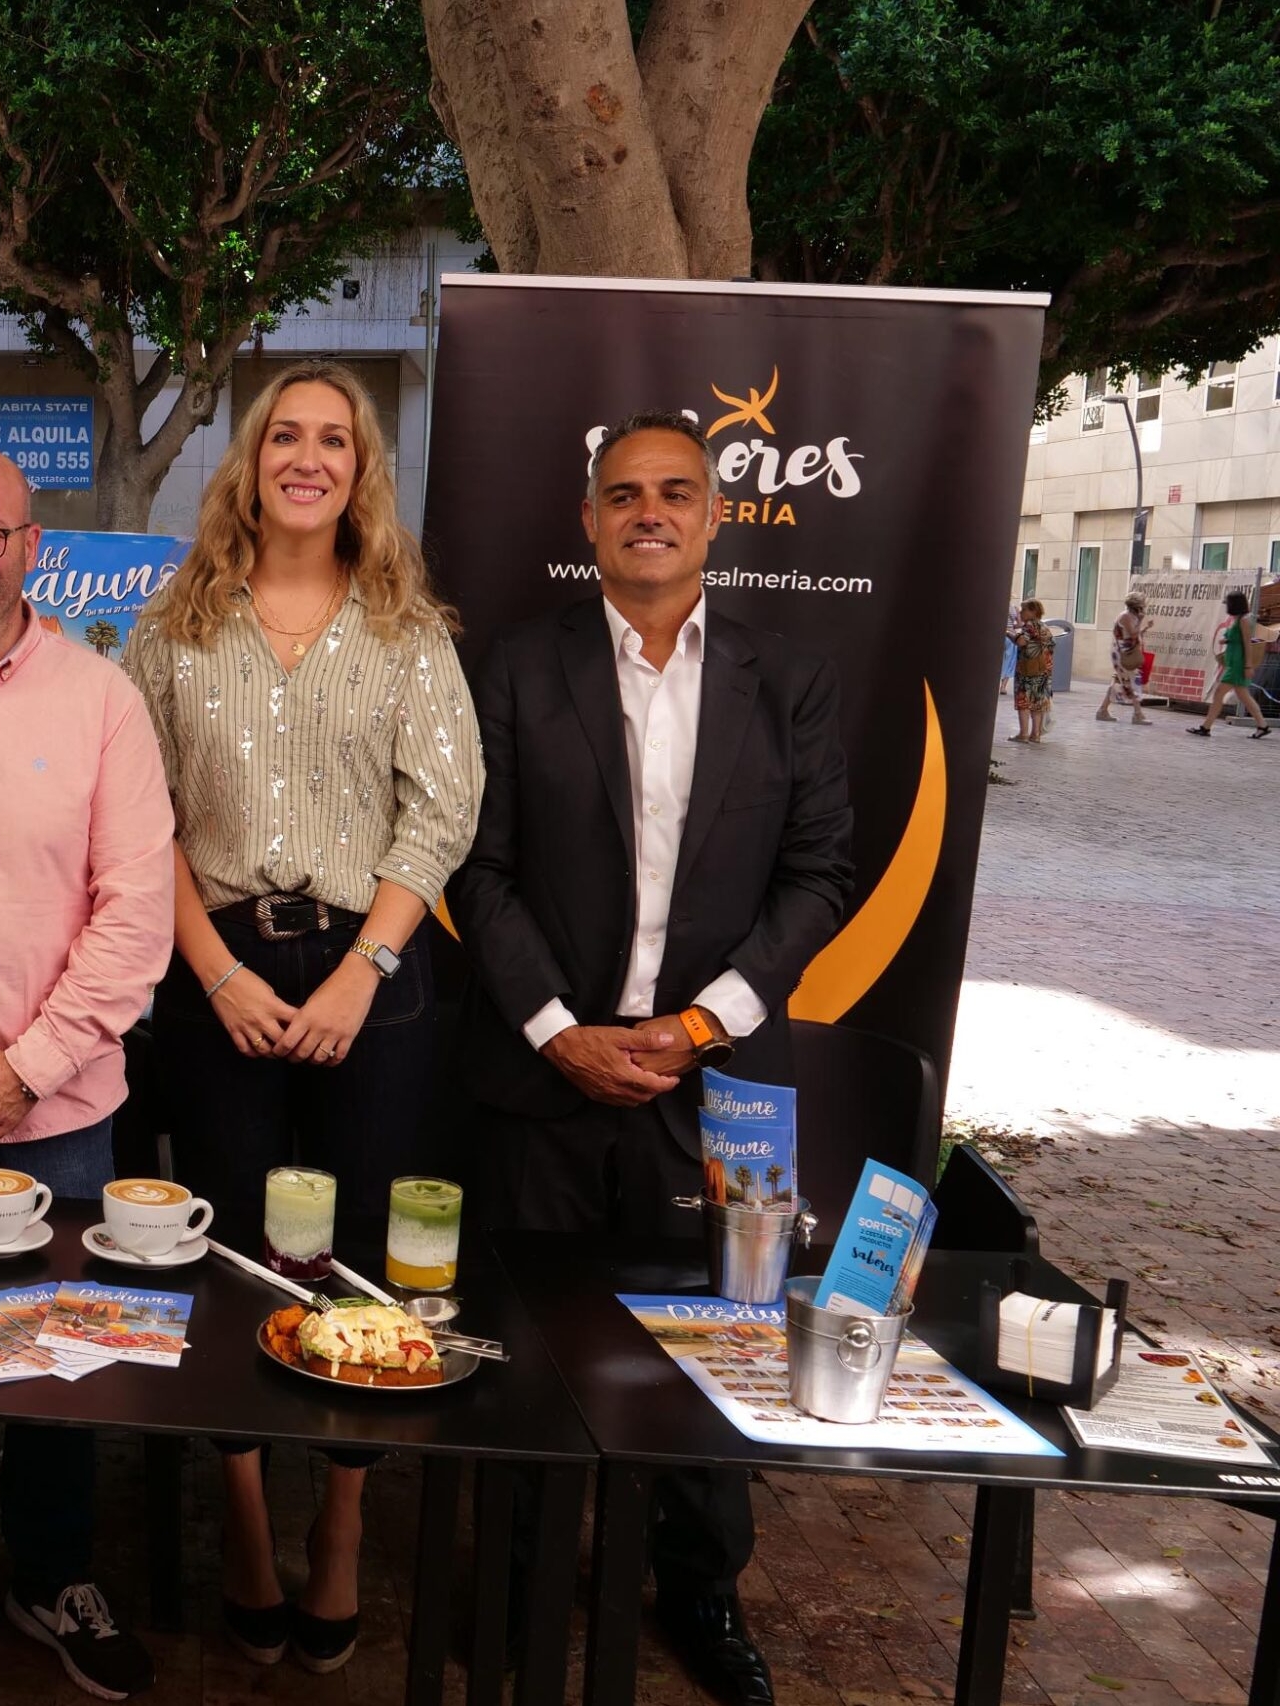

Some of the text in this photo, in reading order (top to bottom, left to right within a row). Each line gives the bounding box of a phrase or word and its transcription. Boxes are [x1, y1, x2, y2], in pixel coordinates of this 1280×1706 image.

[45, 403, 88, 412] STATE
[7, 426, 89, 444] ALQUILA
[16, 451, 89, 469] 980 555
[721, 496, 796, 526] ERÍA
[38, 546, 70, 571] del
[1184, 584, 1191, 599] Y
[1174, 606, 1193, 618] 255
[858, 1217, 903, 1238] SORTEOS
[693, 1303, 724, 1312] Ruta
